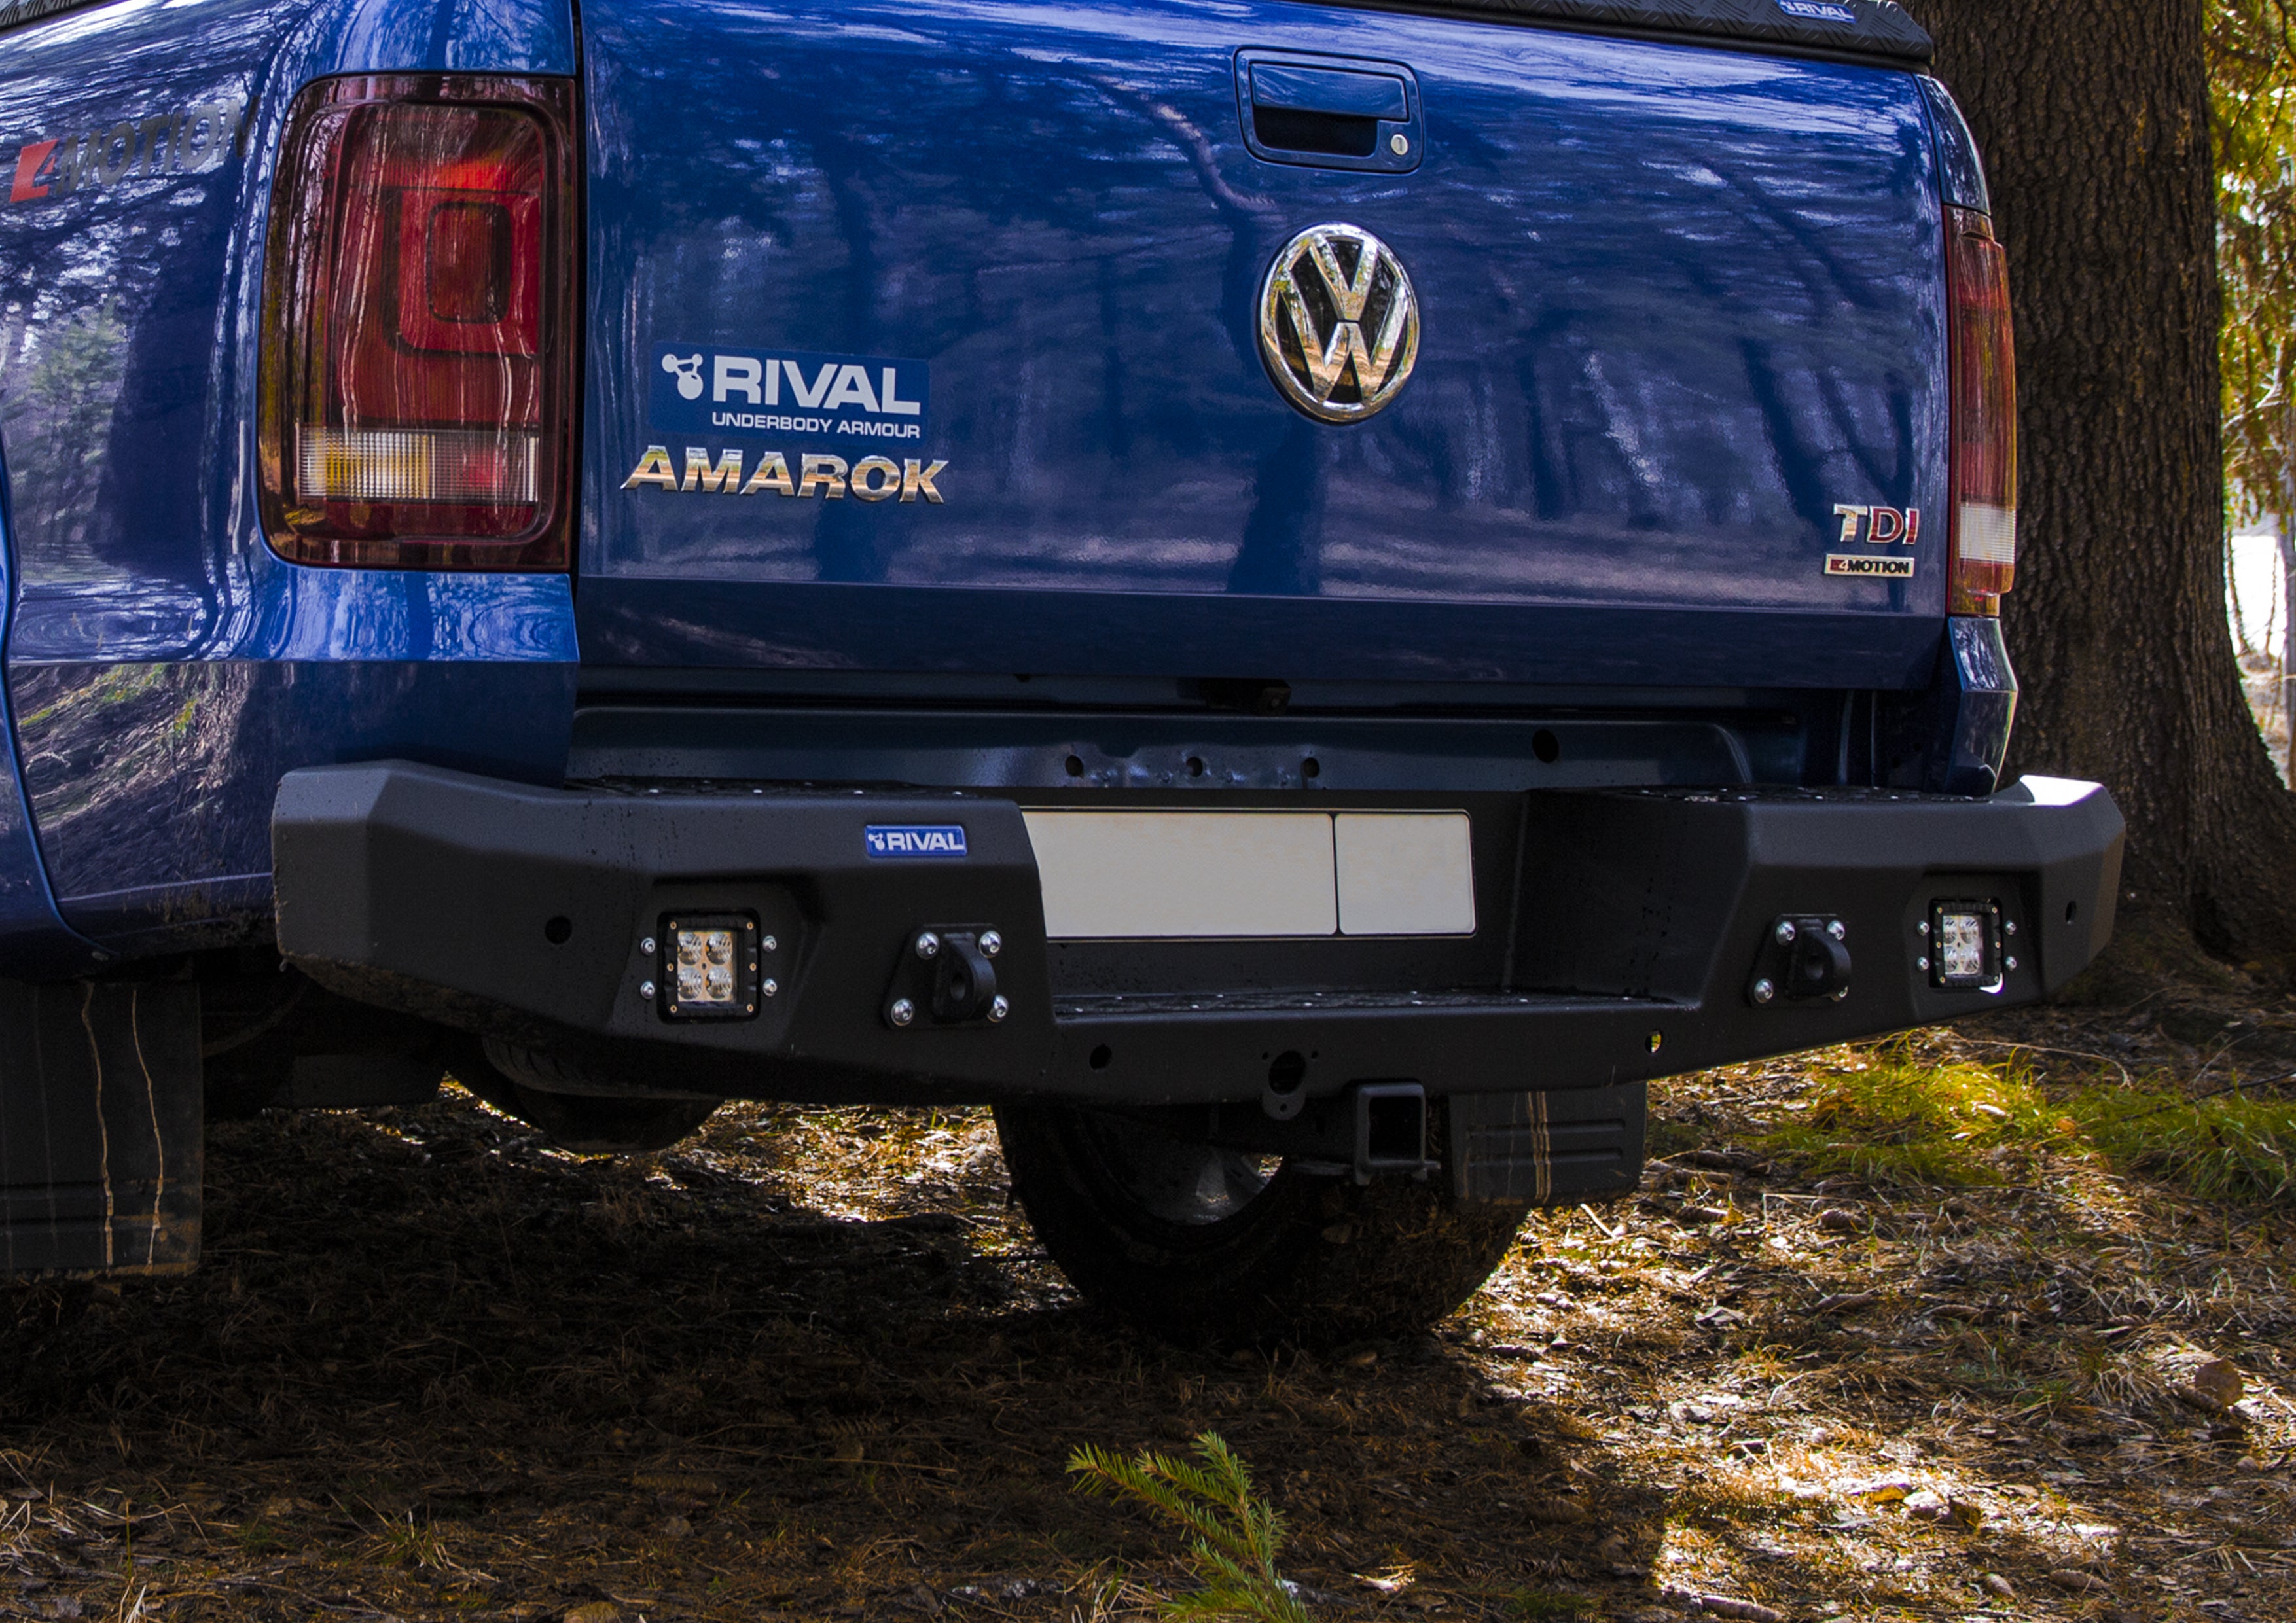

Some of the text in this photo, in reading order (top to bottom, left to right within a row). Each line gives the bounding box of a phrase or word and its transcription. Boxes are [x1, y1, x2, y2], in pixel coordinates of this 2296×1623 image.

[1793, 2, 1854, 19] RIVAL
[713, 355, 920, 415] RIVAL
[712, 412, 920, 439] UNDERBODY ARMOUR
[620, 444, 949, 503] AMAROK
[1833, 503, 1920, 545] TDI
[1830, 558, 1909, 573] 4MOTION
[886, 832, 965, 851] RIVAL
